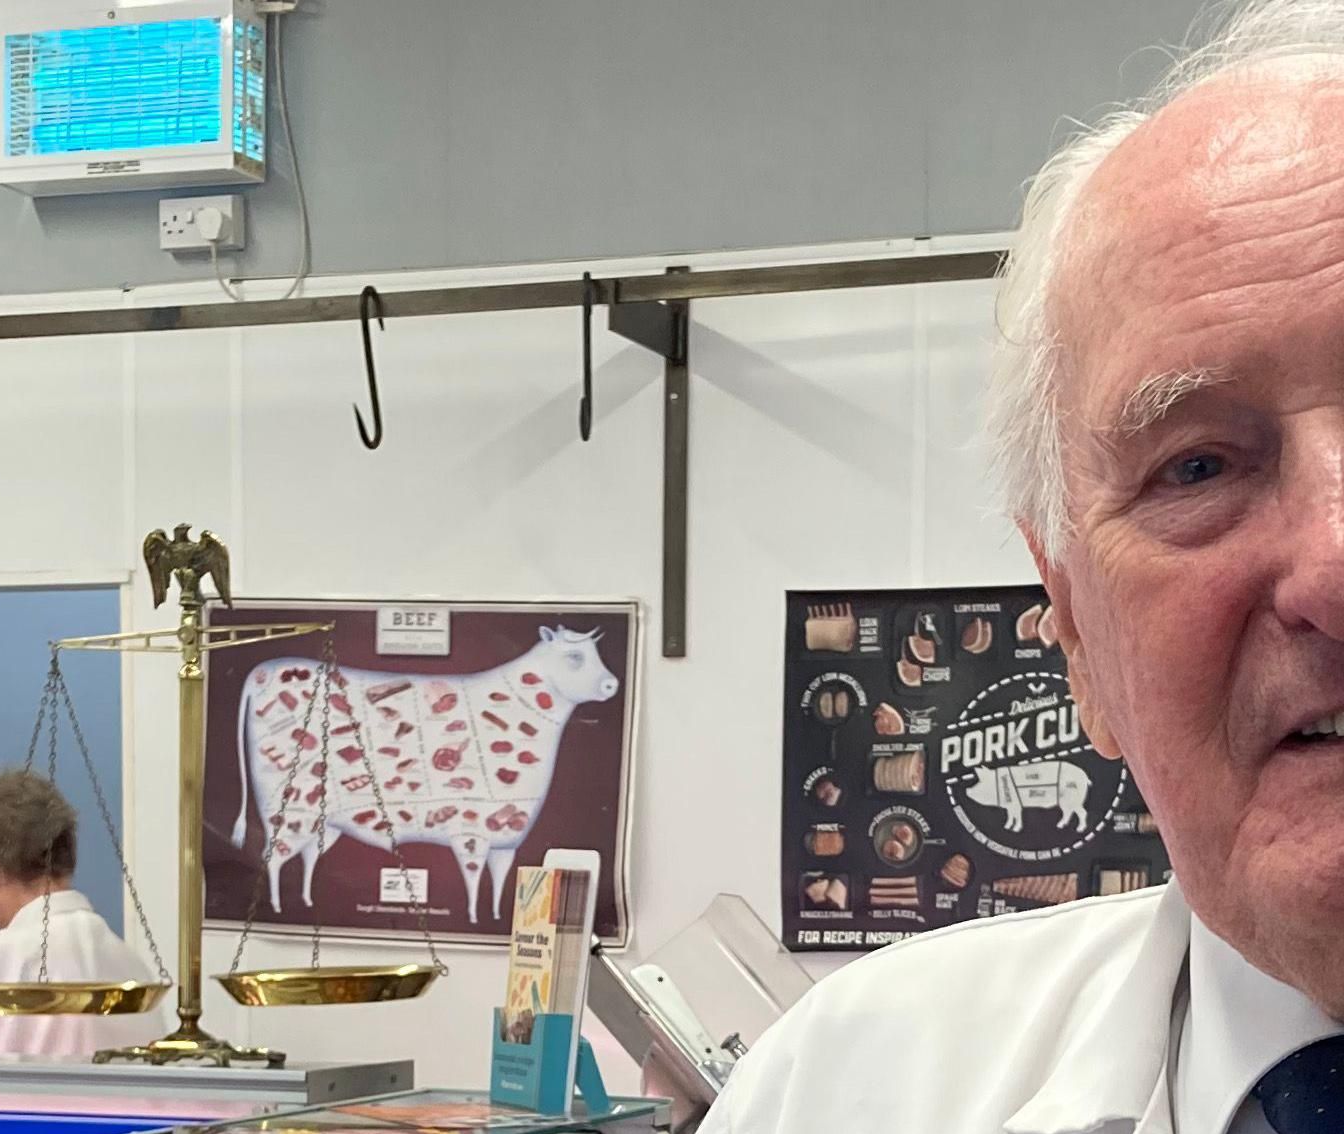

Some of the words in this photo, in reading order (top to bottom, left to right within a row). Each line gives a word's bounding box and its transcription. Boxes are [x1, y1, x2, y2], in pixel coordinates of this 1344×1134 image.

[392, 611, 437, 626] BEEF
[1008, 691, 1059, 716] Delicious
[940, 717, 1030, 774] PORK
[1035, 704, 1080, 750] CU
[536, 932, 549, 945] the
[798, 931, 819, 944] FOR
[823, 931, 862, 944] RECIPE
[516, 943, 542, 959] Seasons
